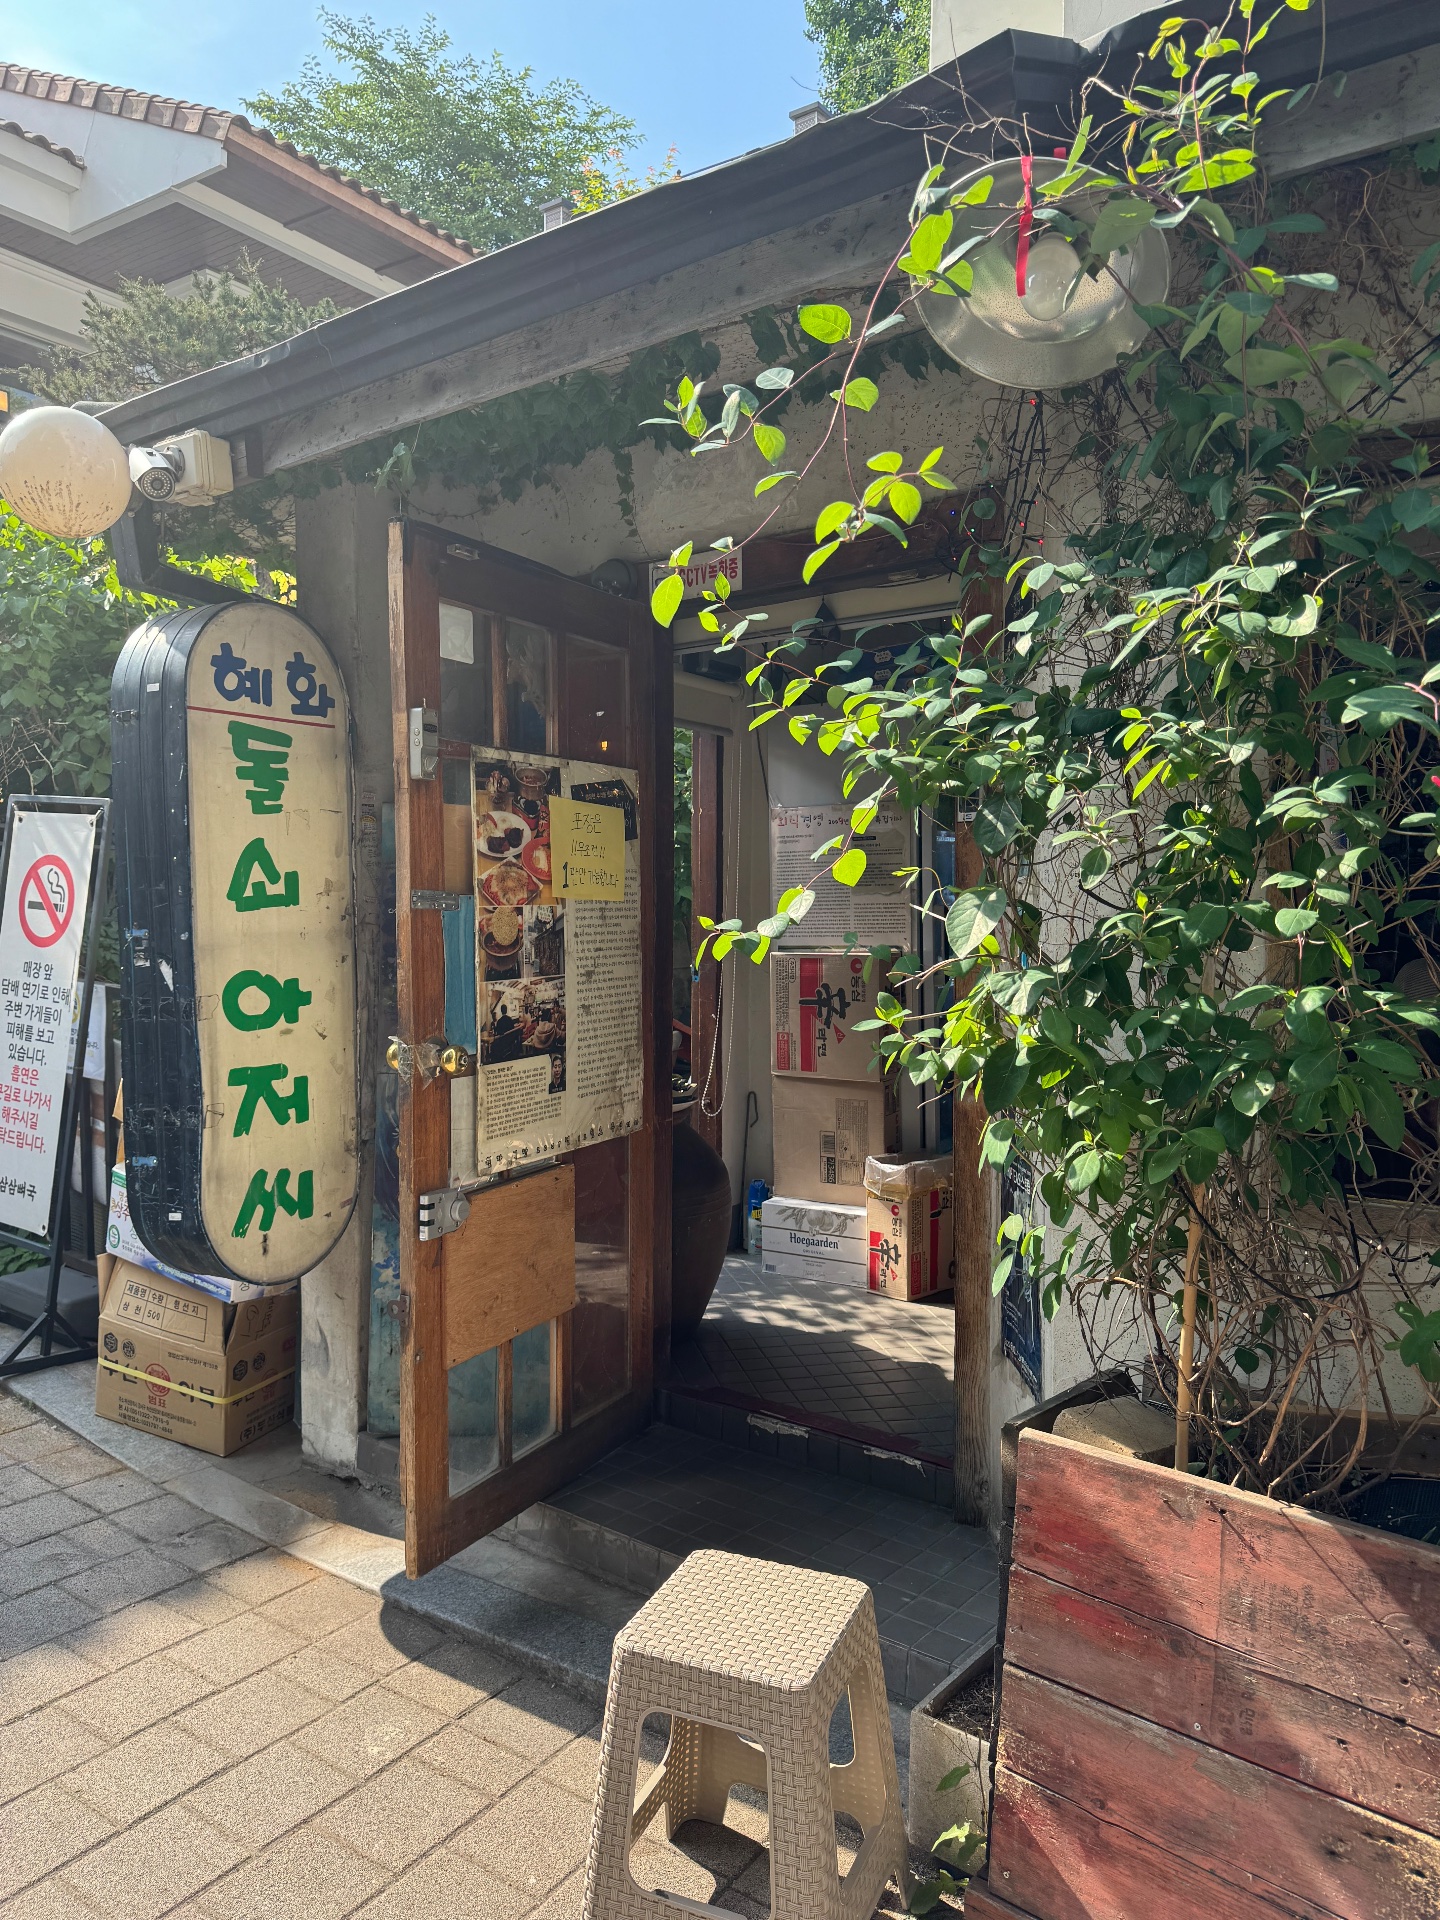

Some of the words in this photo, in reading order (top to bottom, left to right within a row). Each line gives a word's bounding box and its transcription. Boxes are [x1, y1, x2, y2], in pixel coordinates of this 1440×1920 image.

[210, 643, 336, 718] 혜화
[571, 812, 602, 834] 포장은
[23, 960, 42, 979] 매장
[44, 963, 54, 981] 앞
[1, 978, 20, 998] 담배
[22, 982, 49, 1001] 연기로
[52, 986, 72, 1008] 인해
[850, 975, 861, 1002] 농심
[4, 1000, 23, 1019] 주변
[25, 1003, 63, 1026] 가게들이
[6, 1021, 34, 1043] 피해를
[35, 1027, 55, 1045] 보고
[8, 1043, 47, 1067] 있습니다.
[11, 1064, 40, 1087] 흡연은
[23, 1089, 52, 1112] 나가서
[1, 1105, 39, 1131] 해주시길
[790, 1231, 839, 1250] Hoegaarden
[127, 1283, 147, 1299] 제품명
[151, 1292, 164, 1304] 수량
[147, 1309, 161, 1321] 500
